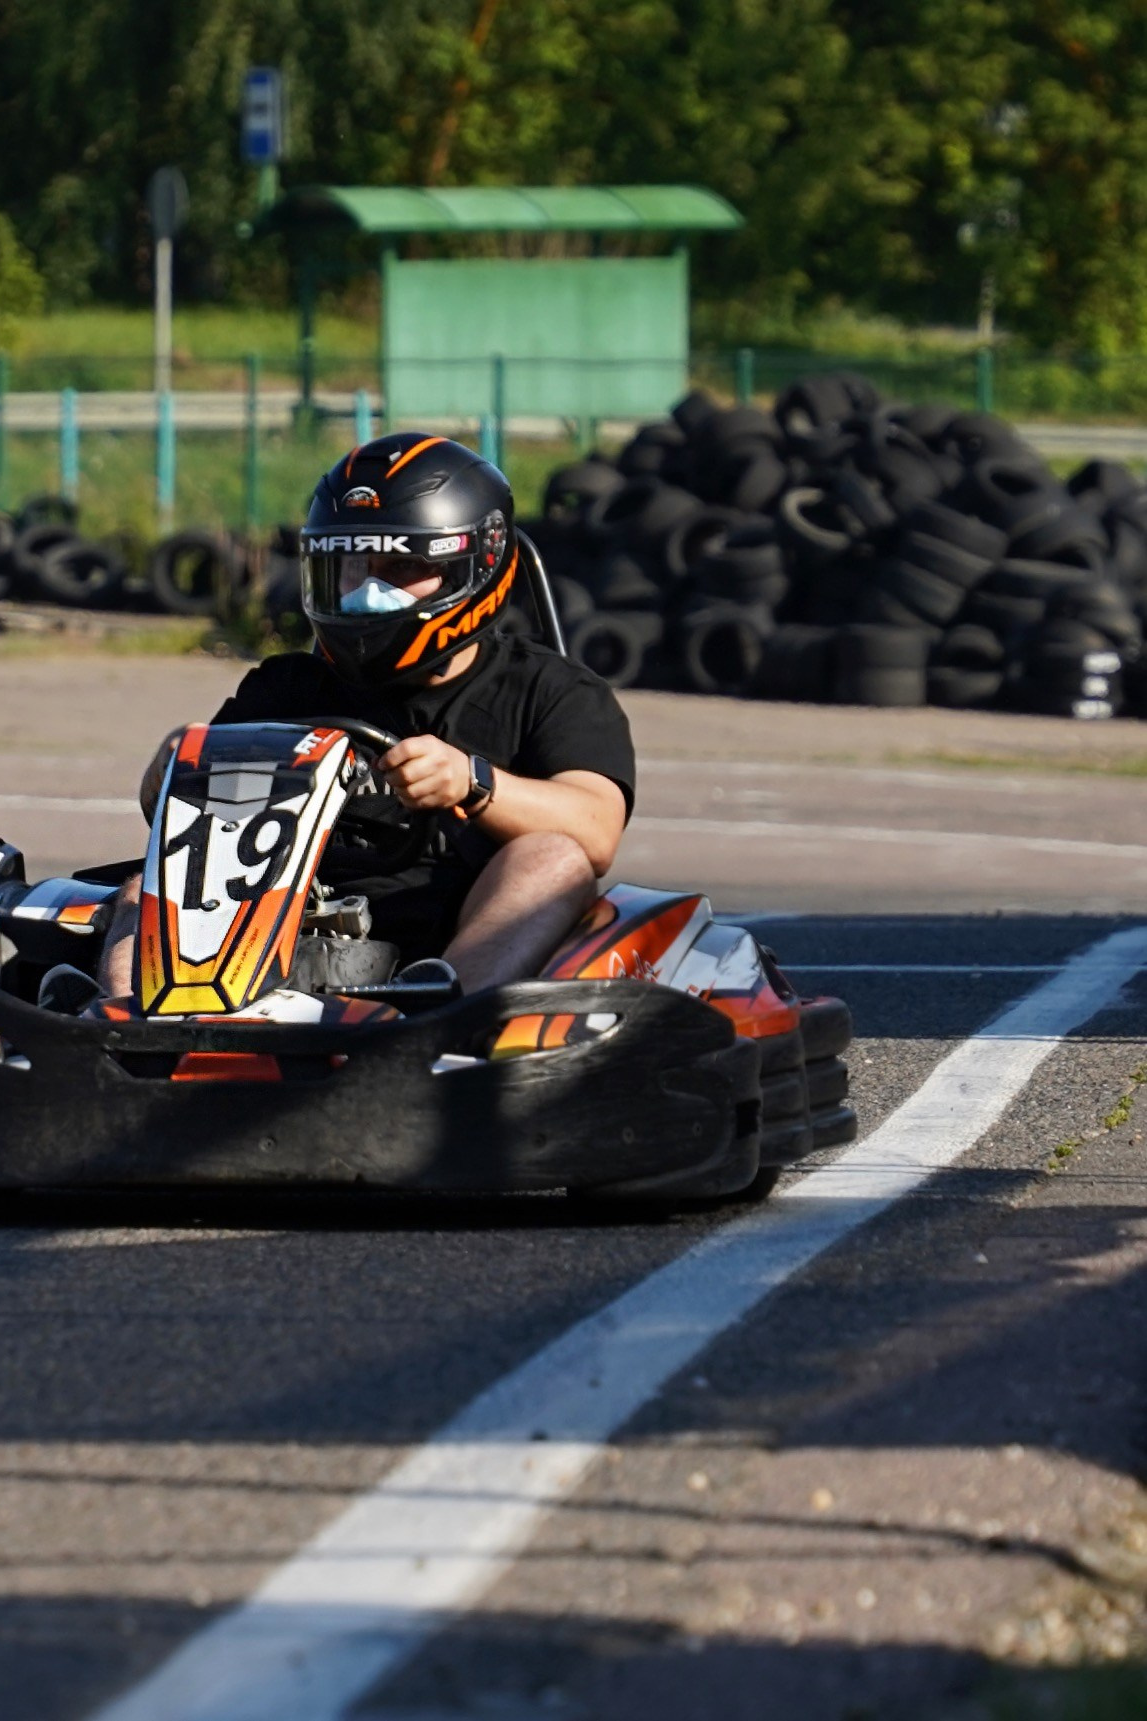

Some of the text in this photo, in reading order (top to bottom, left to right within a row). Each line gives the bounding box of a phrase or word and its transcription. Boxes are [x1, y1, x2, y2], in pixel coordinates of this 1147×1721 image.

[309, 535, 412, 553] МАЯК
[437, 546, 519, 650] МАЯ
[165, 808, 300, 910] 19
